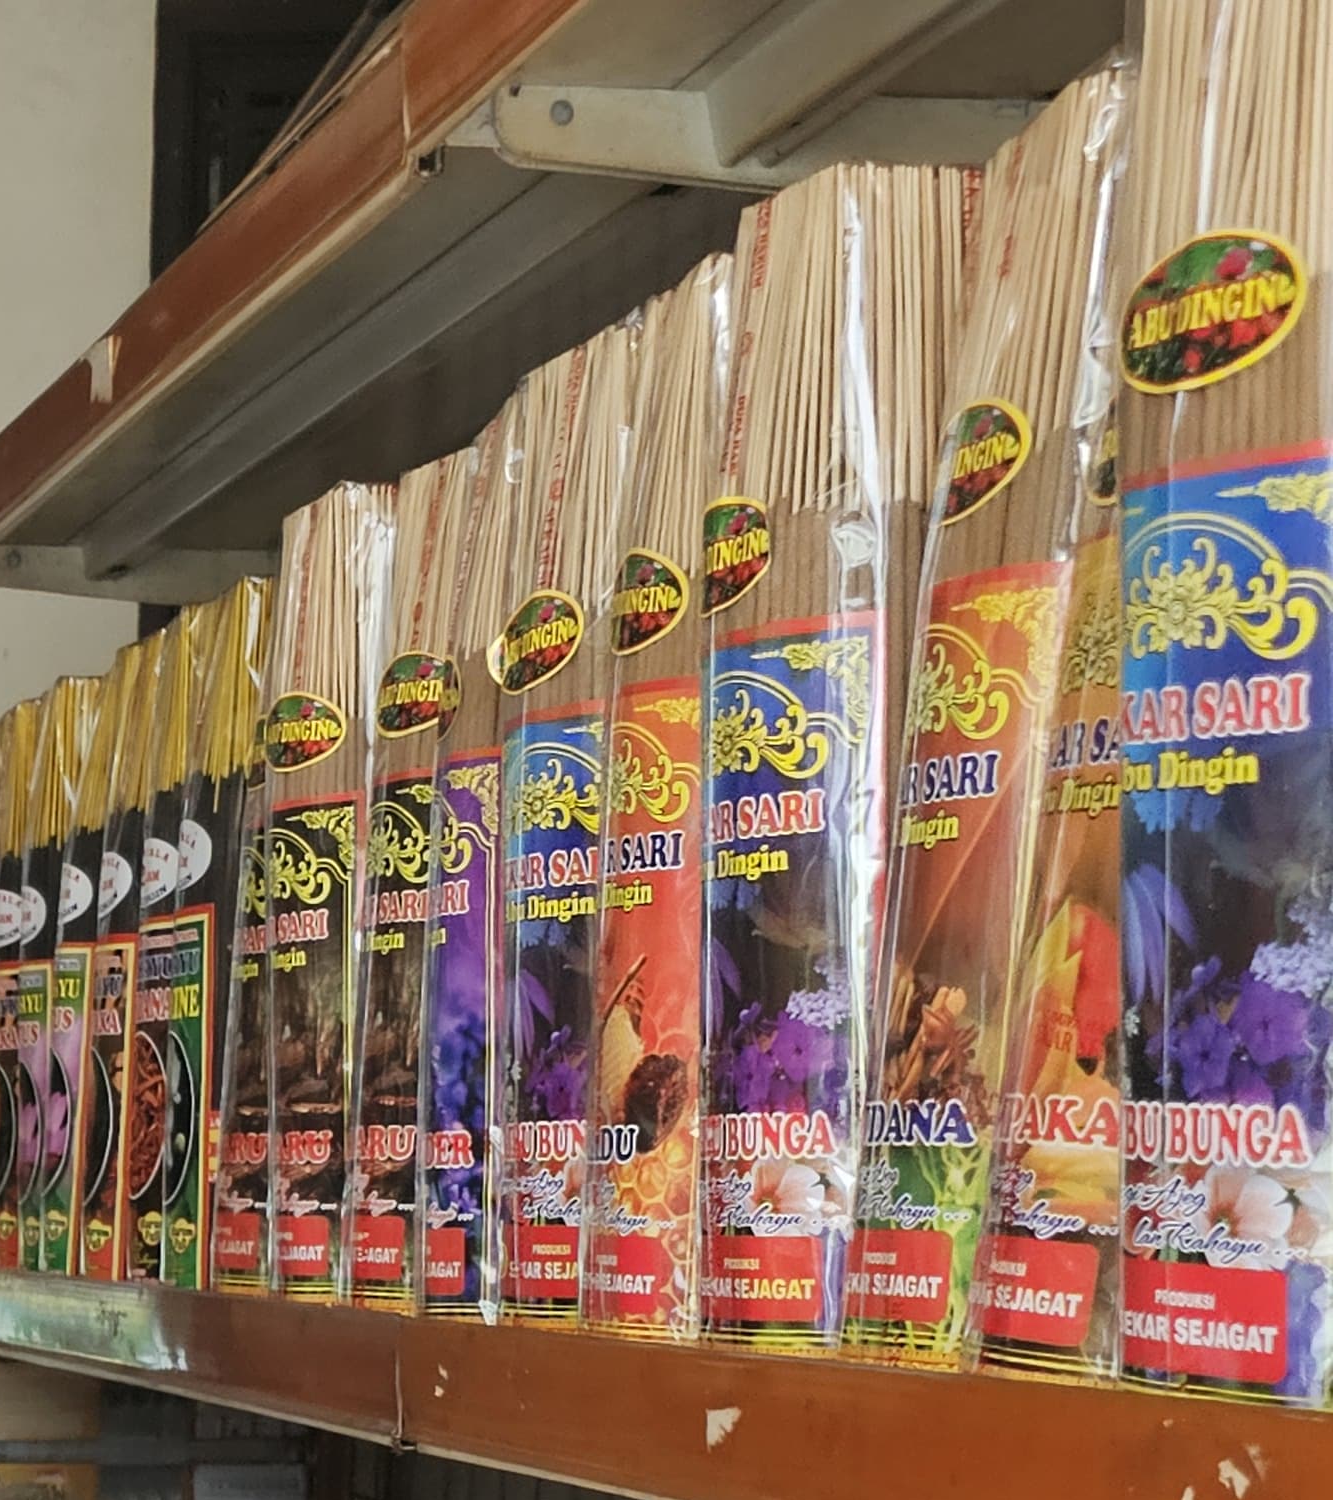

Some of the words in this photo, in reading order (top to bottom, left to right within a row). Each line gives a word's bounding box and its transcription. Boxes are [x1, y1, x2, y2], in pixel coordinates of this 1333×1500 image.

[1174, 271, 1296, 334] DINGIN
[1194, 673, 1310, 740] SARI
[922, 750, 1000, 803] SARI
[1158, 747, 1259, 795] Dingin
[736, 789, 824, 840] SARI
[619, 830, 685, 873] SARI
[716, 844, 788, 884] Dingin
[724, 1109, 837, 1161] BUNGA
[1163, 1101, 1310, 1168] BUNGA
[1164, 1222, 1266, 1265] Rahayu
[733, 1277, 816, 1301] SEJAGAT
[871, 1273, 943, 1300] SEJAGAT
[994, 1286, 1083, 1319] SEJAGAT
[1153, 1288, 1215, 1312] PRODUKSI
[1172, 1316, 1279, 1355] SEJAGAT
